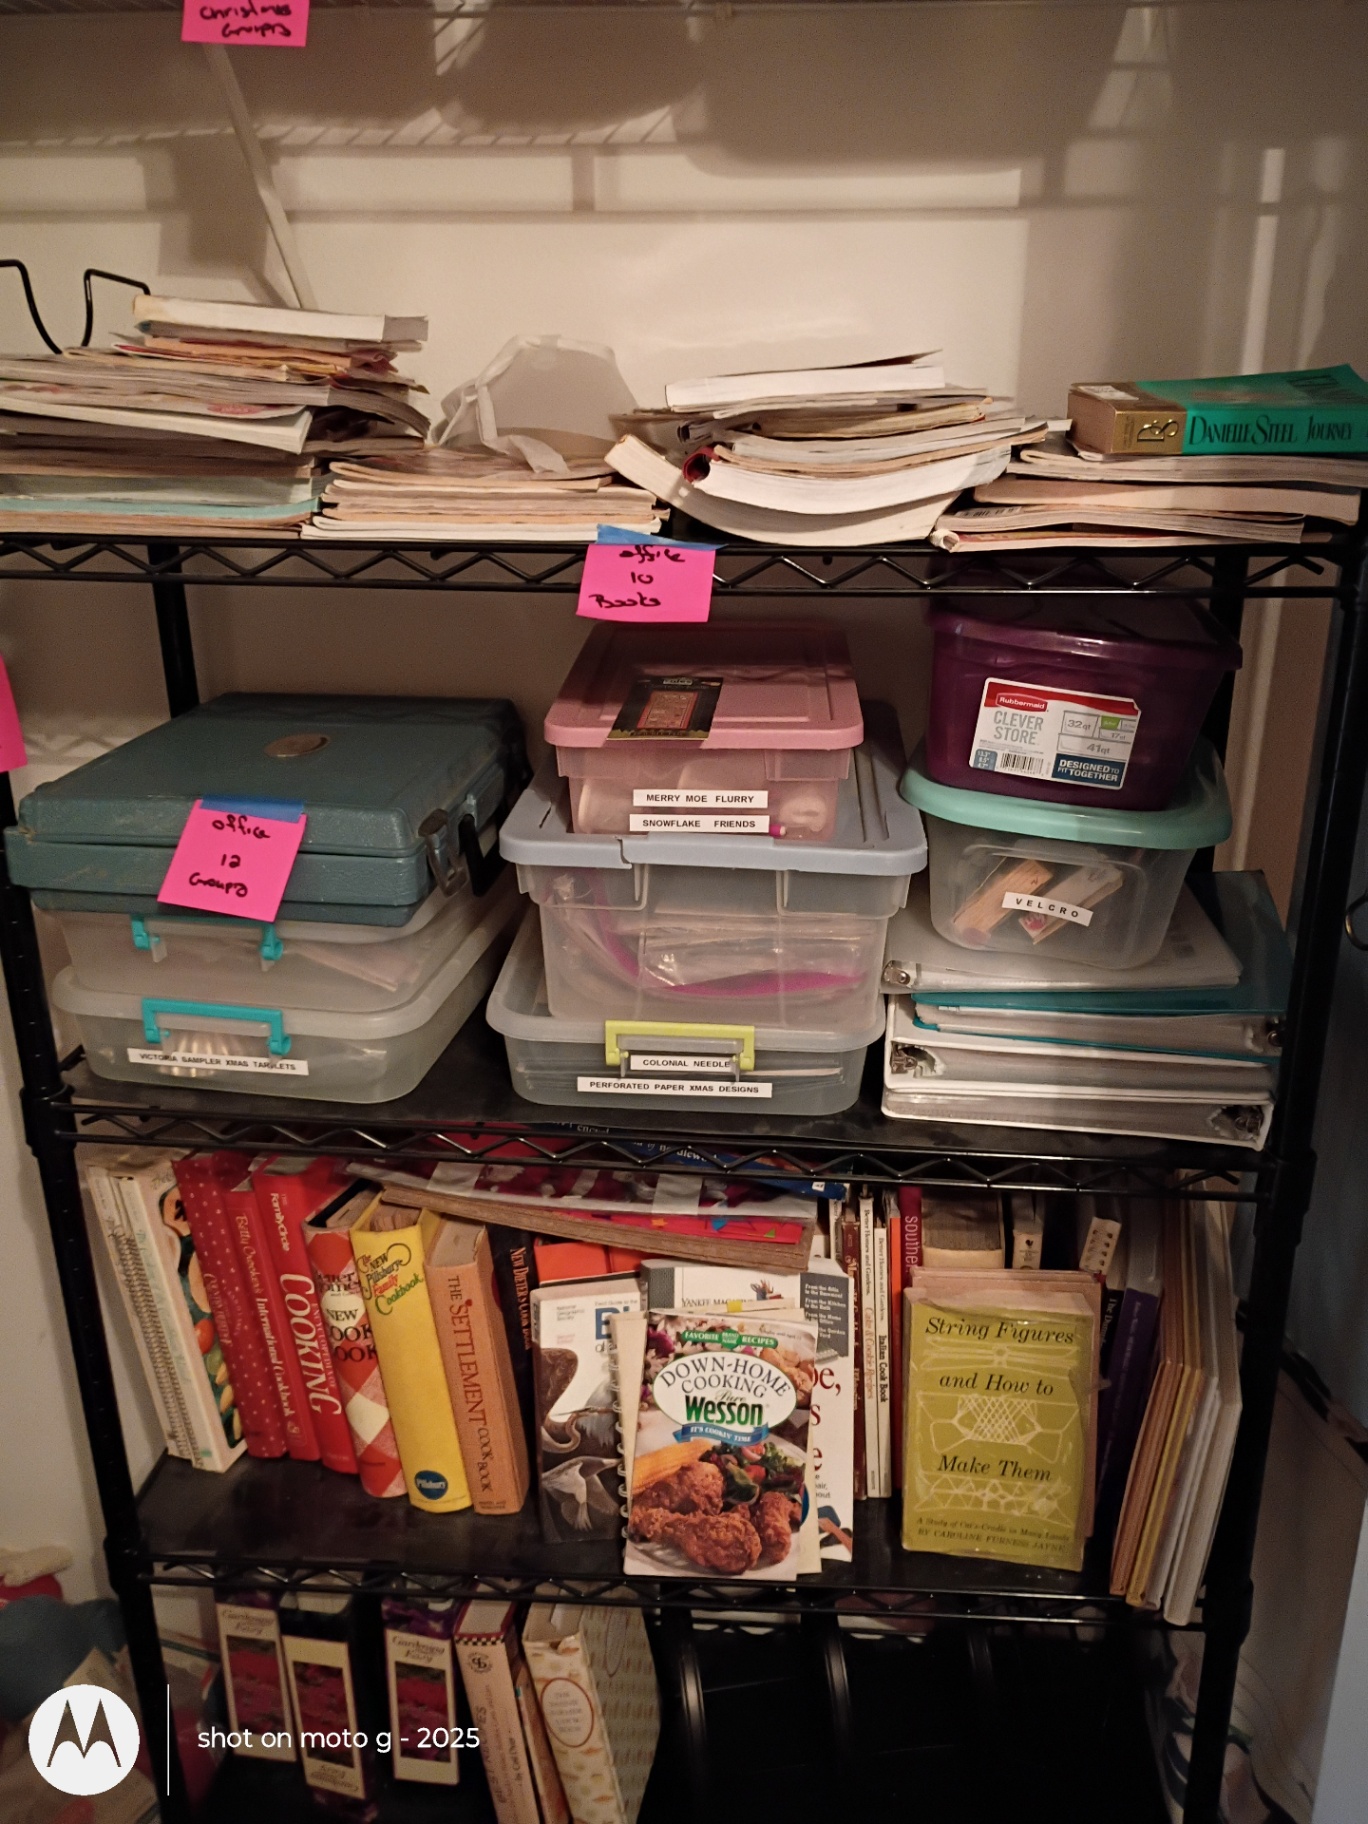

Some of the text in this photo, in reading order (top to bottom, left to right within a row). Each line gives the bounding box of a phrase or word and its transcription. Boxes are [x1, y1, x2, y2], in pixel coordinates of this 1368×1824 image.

[999, 695, 1045, 710] Rubbermaid
[994, 710, 1044, 731] CLEVER
[994, 726, 1036, 745] STORE
[1059, 759, 1110, 774] DESIGNED
[1069, 768, 1118, 782] TOGETHER
[646, 794, 754, 803] MERRY MOE FLURRY
[642, 819, 756, 828] SNOWFLAKE FRIENDS
[1015, 898, 1079, 918] VELCRO
[140, 1053, 178, 1062] VICTORIA
[181, 1056, 221, 1066] SAMPLER
[226, 1059, 249, 1067] XMAS
[642, 1059, 689, 1067] COLONIAL
[589, 1081, 649, 1090] PERFORATED
[654, 1084, 684, 1092] PAPER
[718, 1086, 759, 1094] DESIGNS
[370, 1252, 388, 1272] NEW
[509, 1247, 527, 1266] NEW
[375, 1273, 423, 1316] Cookbook
[448, 1276, 462, 1301] THE
[325, 1308, 359, 1322] NEW
[684, 1331, 719, 1340] FAVORITE
[741, 1335, 775, 1345] RECIPES
[925, 1315, 990, 1340] String
[994, 1321, 1074, 1344] Figures
[280, 1273, 342, 1415] COOKING
[879, 1335, 887, 1360] Italian
[449, 1303, 488, 1427] SETTLEMENT
[879, 1361, 888, 1382] Cook
[660, 1355, 791, 1397] DOWN-HOME
[681, 1374, 767, 1398] COOKING
[939, 1372, 1054, 1395] and How to
[880, 1382, 889, 1402] Book
[685, 1394, 764, 1426] Wesson
[734, 1434, 751, 1442] TIME
[937, 1455, 1052, 1481] Make Them
[917, 1528, 929, 1536] BY
[933, 1530, 982, 1541] CAROLINE
